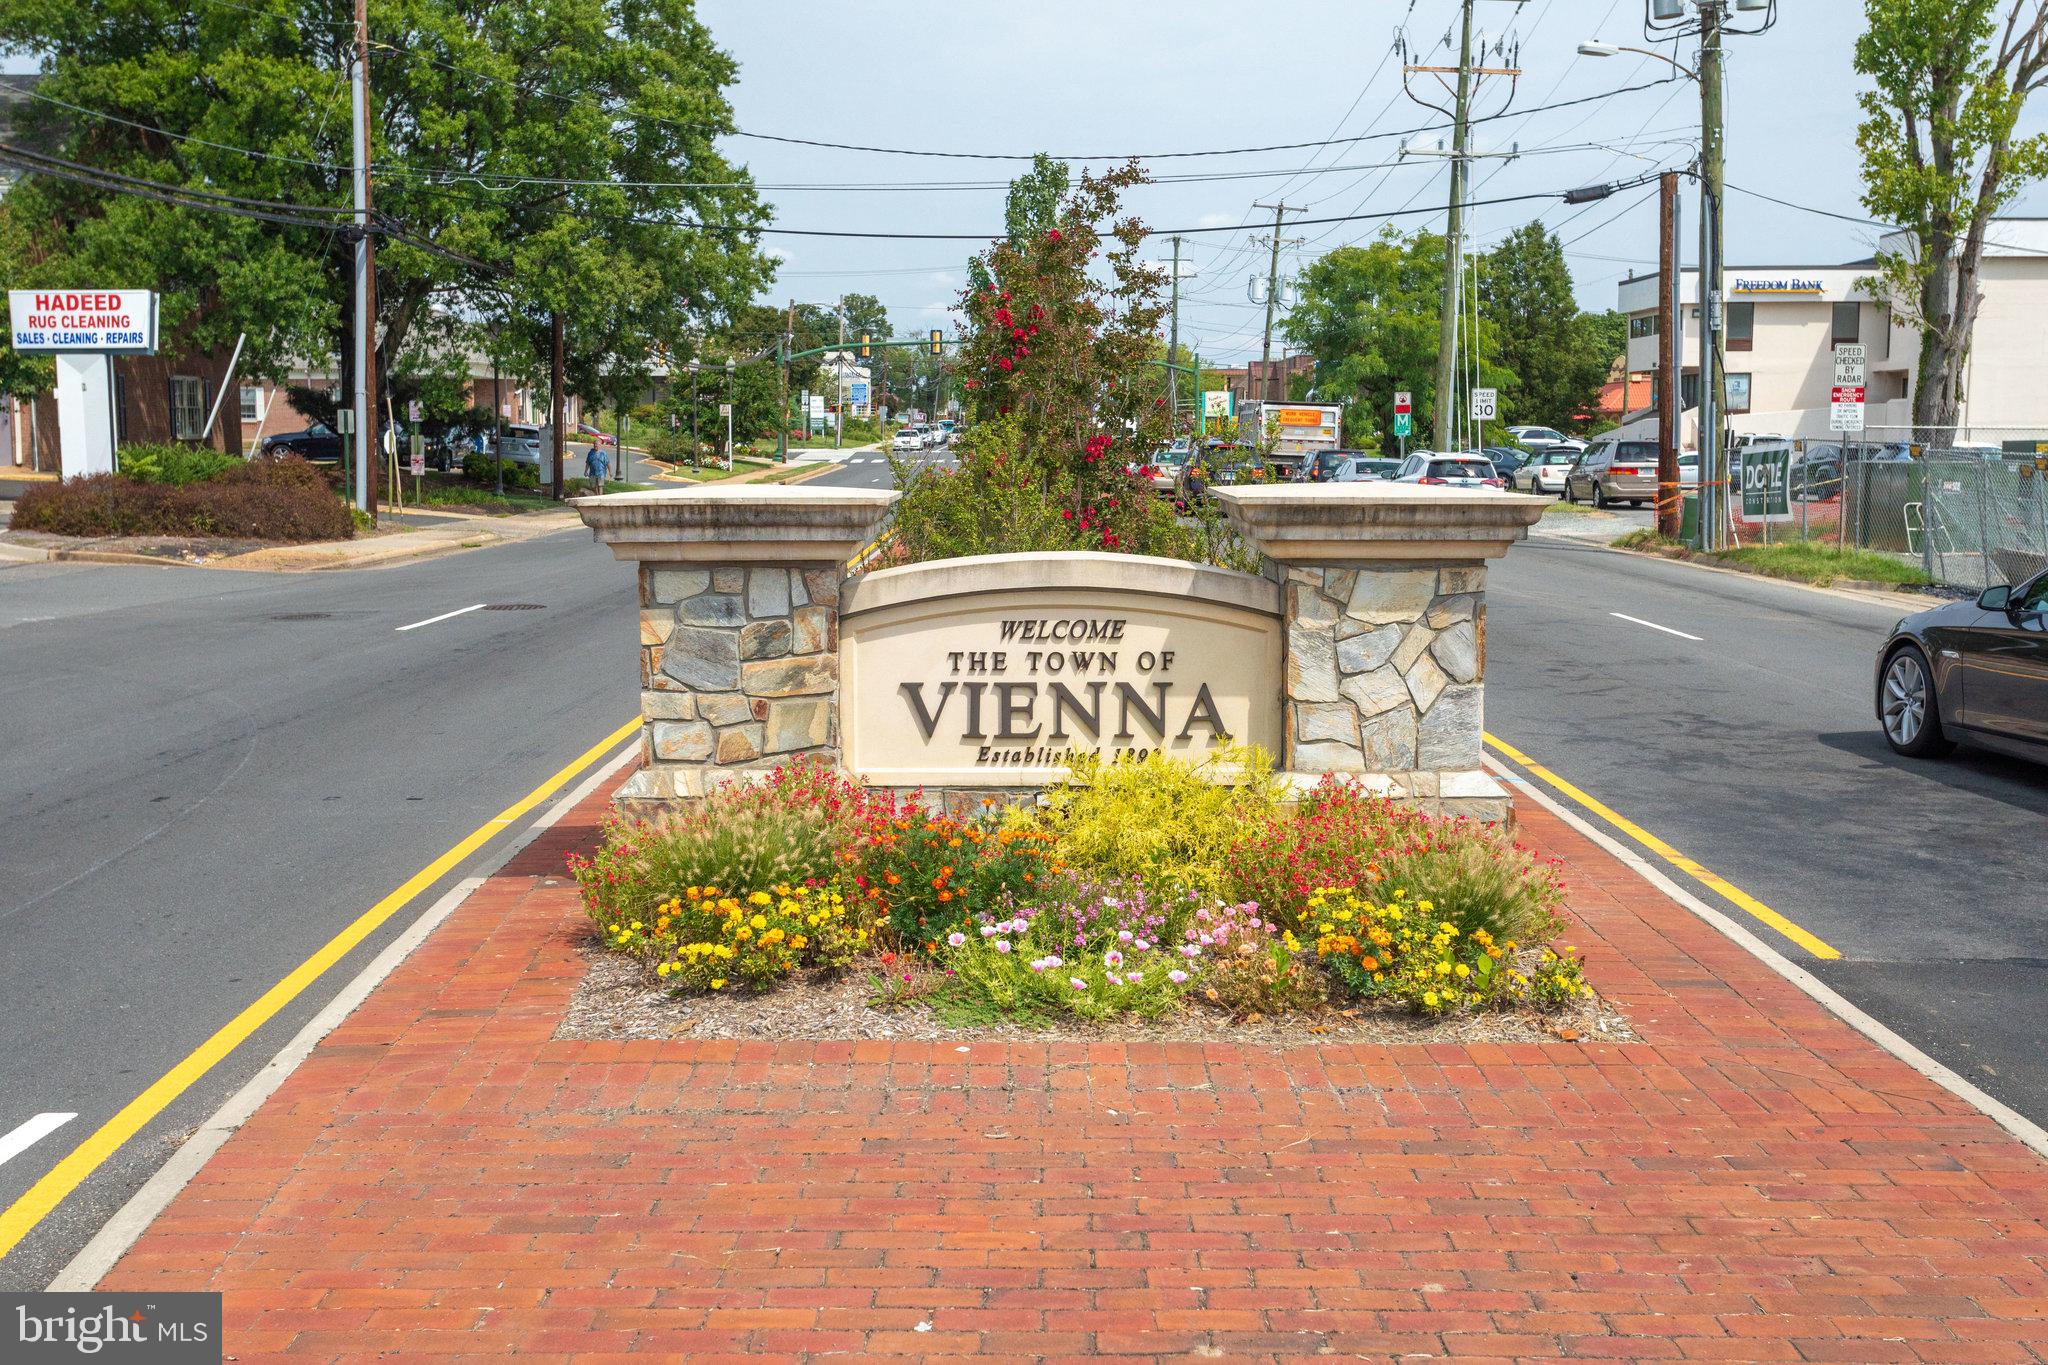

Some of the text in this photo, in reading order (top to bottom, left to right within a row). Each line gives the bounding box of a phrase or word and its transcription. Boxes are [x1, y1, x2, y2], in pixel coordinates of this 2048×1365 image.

[1735, 278, 1824, 291] FREEDOM BANK
[35, 294, 122, 311] HADEED
[28, 315, 130, 328] RUG CLEANING
[17, 332, 143, 344] SALES CLEANING REPAIRS
[1838, 347, 1862, 356] SPEED
[1835, 356, 1865, 365] CHECKED
[1844, 365, 1855, 374] BY
[1836, 375, 1862, 383] RADAR
[1474, 404, 1494, 416] 30
[1397, 414, 1409, 426] M
[1000, 619, 1127, 640] WELCOME
[949, 651, 1176, 672] THE TOWN OF
[899, 681, 1234, 739] VIENNA
[976, 746, 1101, 763] Established
